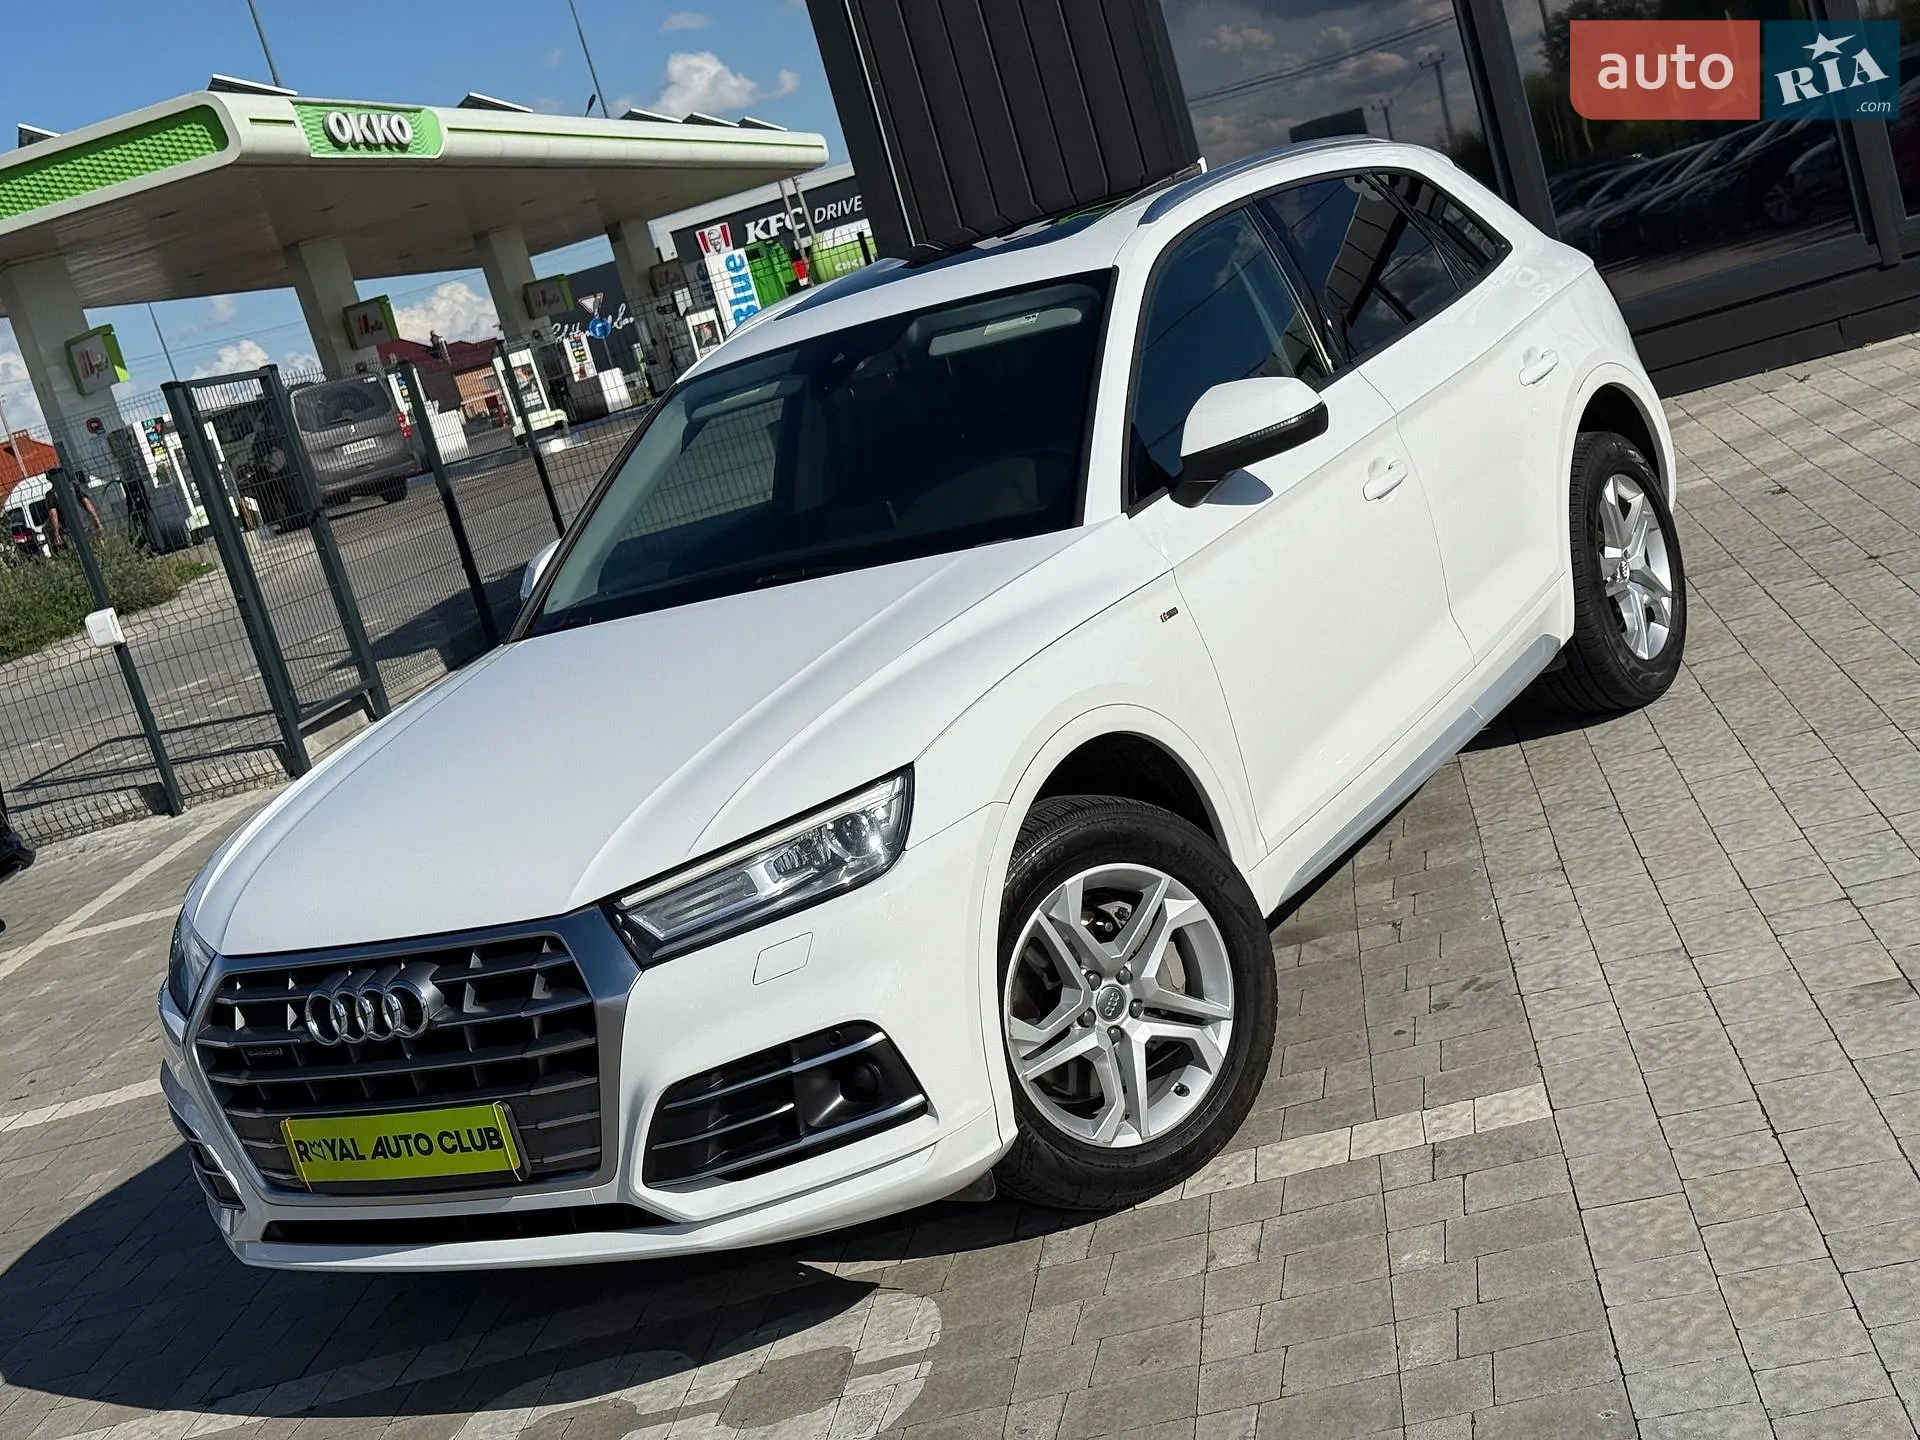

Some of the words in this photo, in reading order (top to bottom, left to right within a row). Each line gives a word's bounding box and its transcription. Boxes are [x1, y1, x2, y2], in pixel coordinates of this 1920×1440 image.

[326, 112, 413, 145] OKKO
[745, 207, 806, 244] KFC
[814, 195, 863, 224] DRIVE
[370, 1132, 434, 1160] AUTO
[437, 1126, 504, 1154] CLUB
